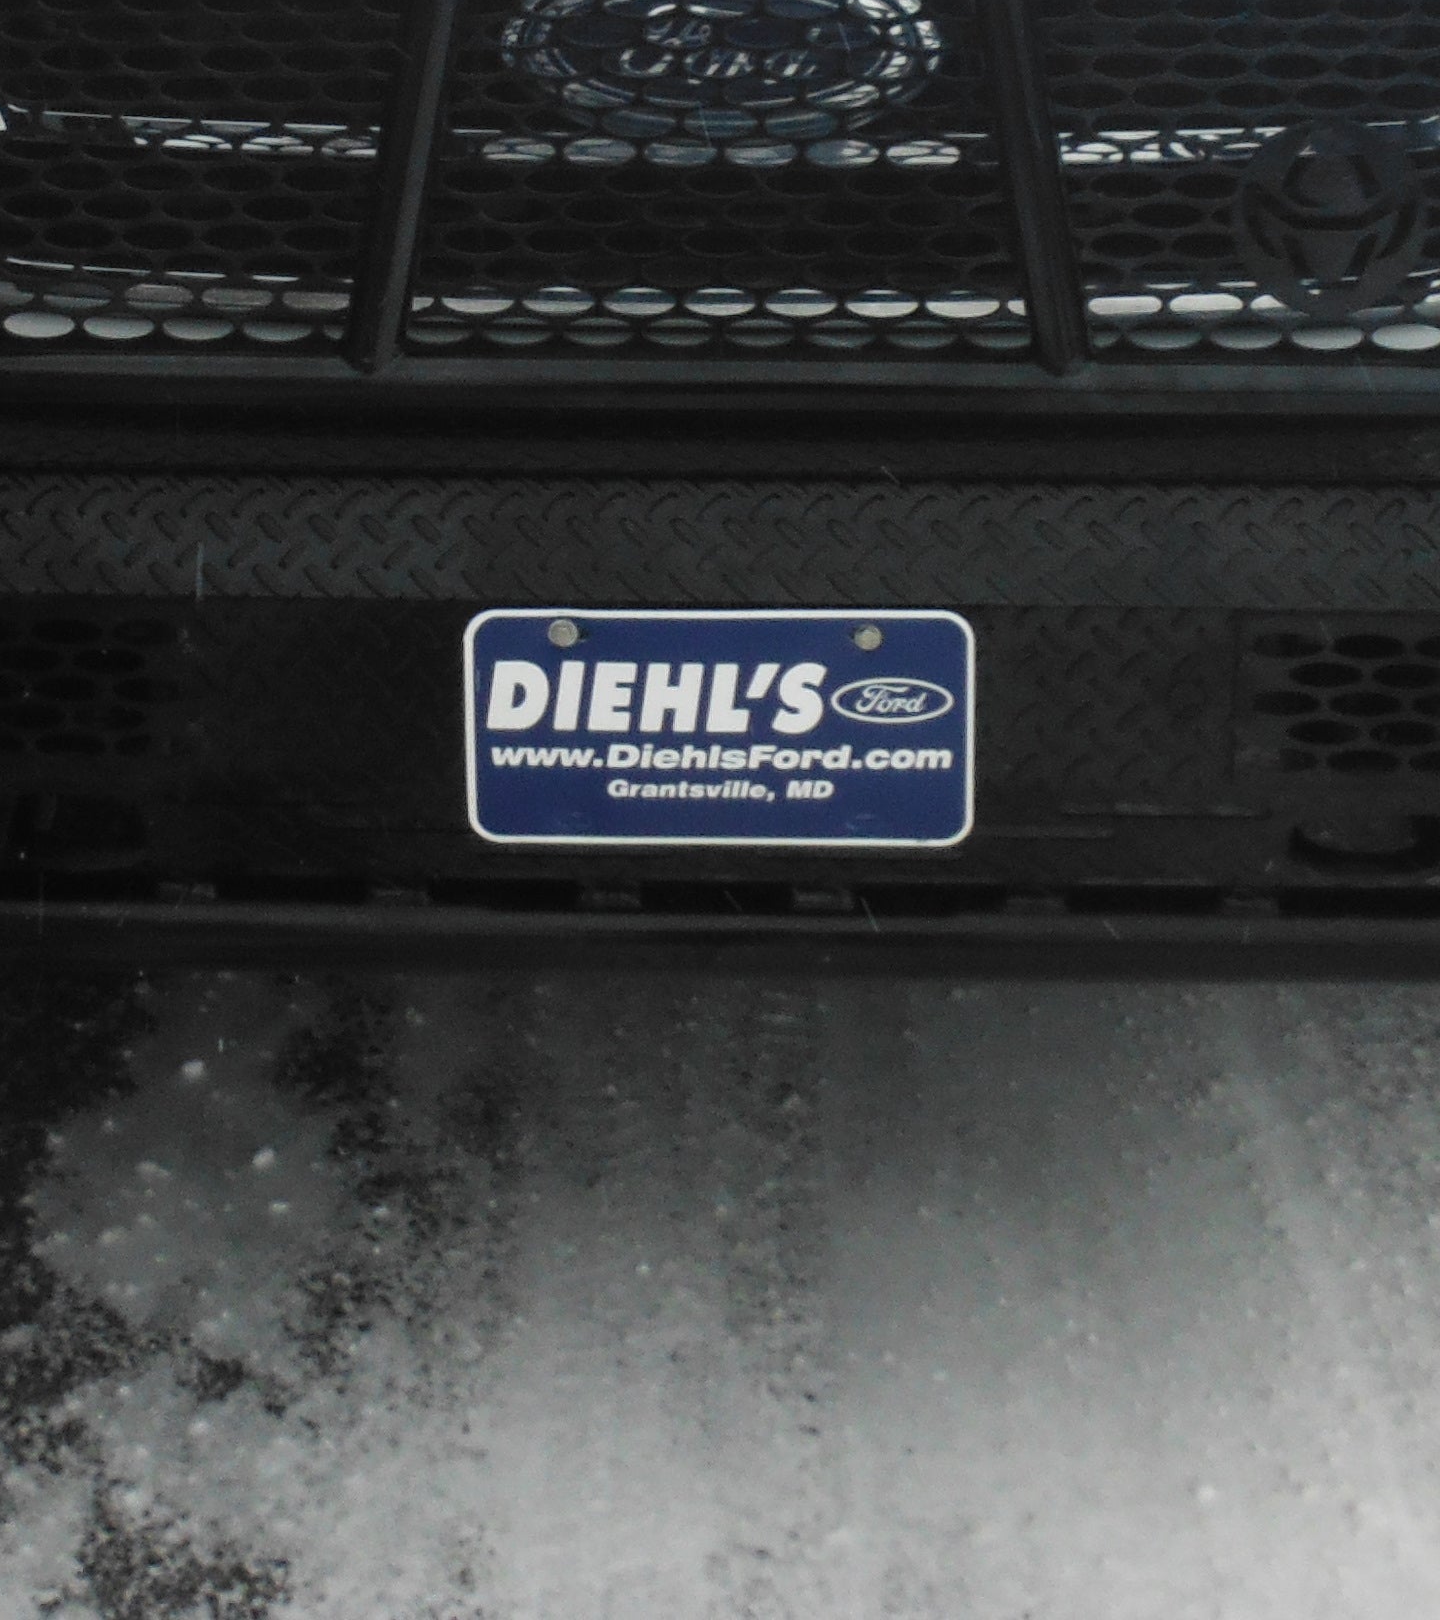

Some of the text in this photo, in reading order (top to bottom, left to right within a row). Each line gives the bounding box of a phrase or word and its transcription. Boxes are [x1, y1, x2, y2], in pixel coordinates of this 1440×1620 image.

[486, 660, 928, 734] DIEHL'S Ford
[491, 744, 953, 771] www.DiehlsFord.com
[607, 779, 835, 802] Grantsville, MD
